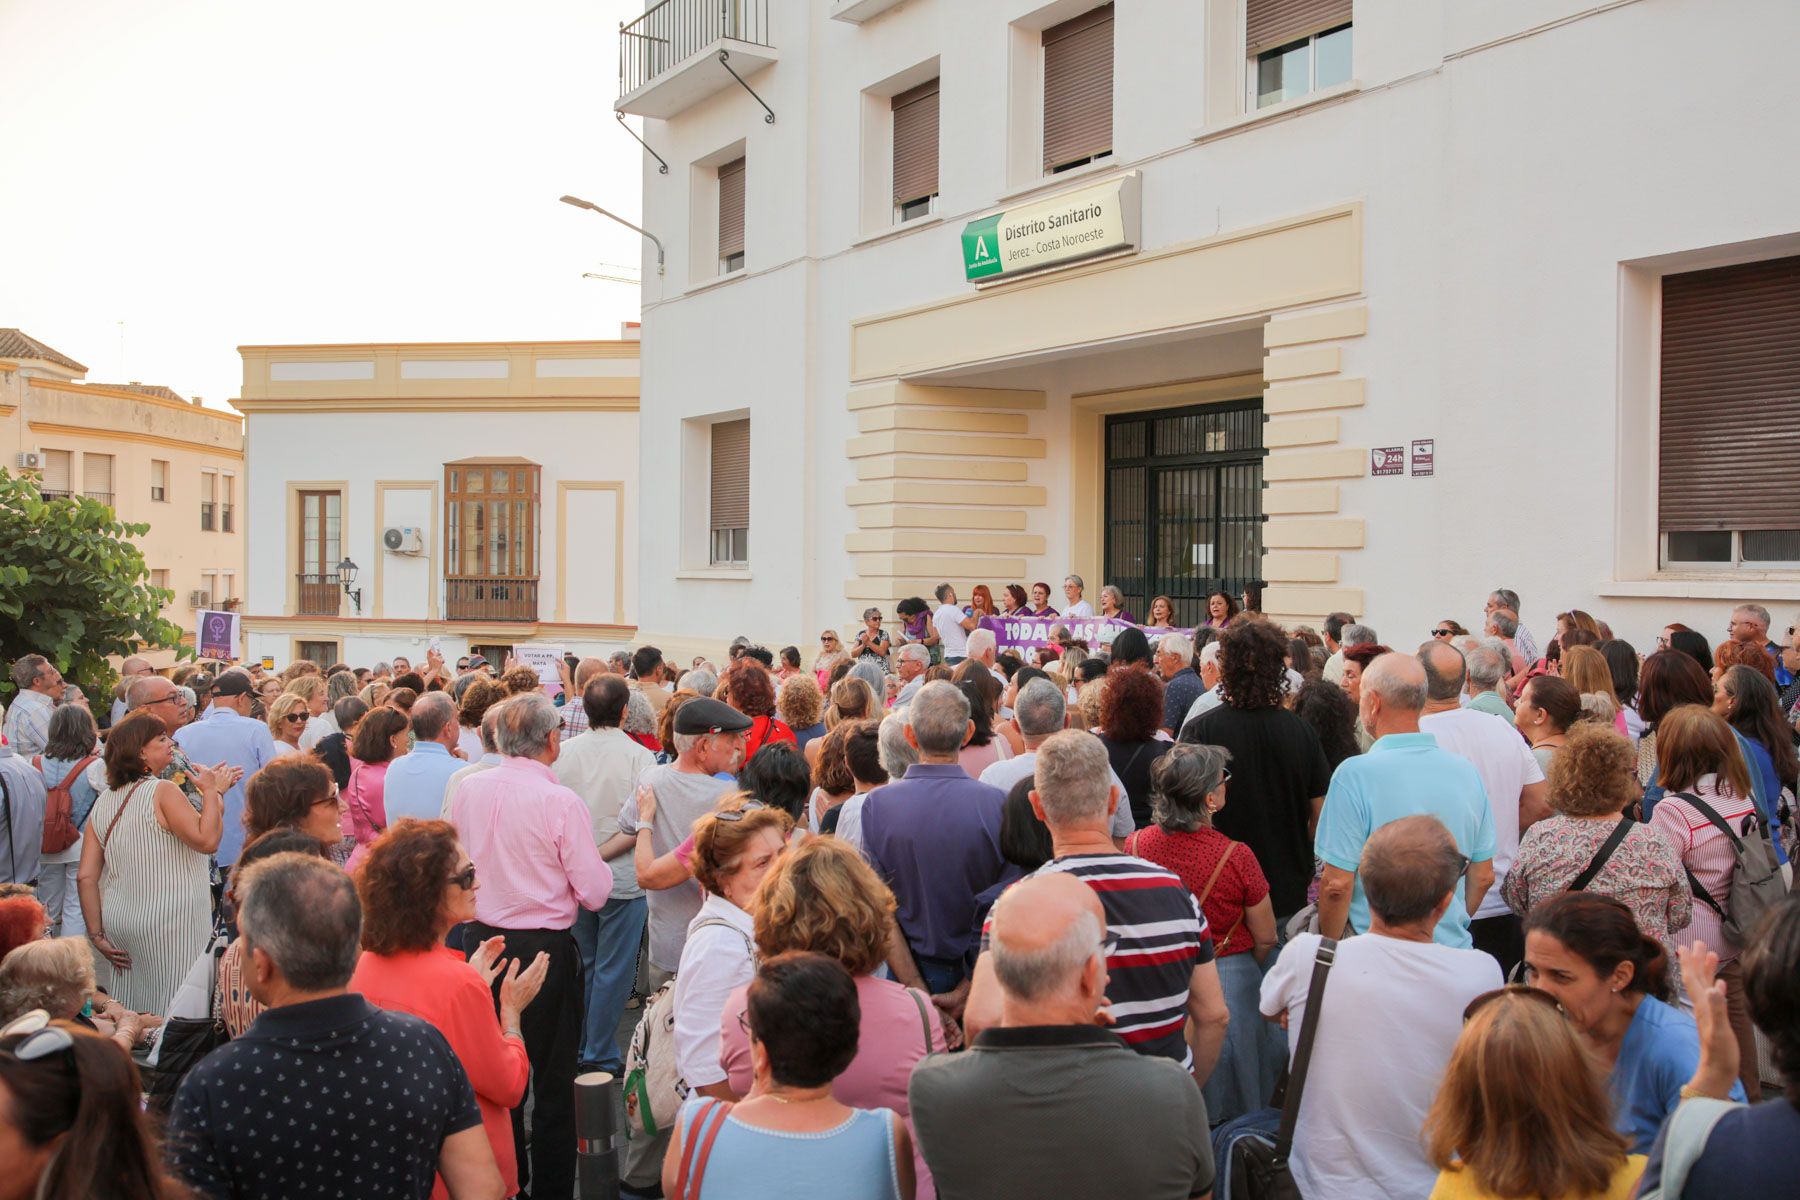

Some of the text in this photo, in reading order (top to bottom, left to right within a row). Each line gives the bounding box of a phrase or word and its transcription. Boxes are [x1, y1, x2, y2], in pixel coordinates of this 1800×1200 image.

[1006, 203, 1102, 241] Distrito Sanitario
[1008, 247, 1029, 261] Jerez
[1036, 239, 1061, 254] Costa
[1062, 228, 1104, 247] Noroeste
[1387, 454, 1403, 463] 24h
[1005, 623, 1054, 641] TODA
[1064, 623, 1094, 641] AS
